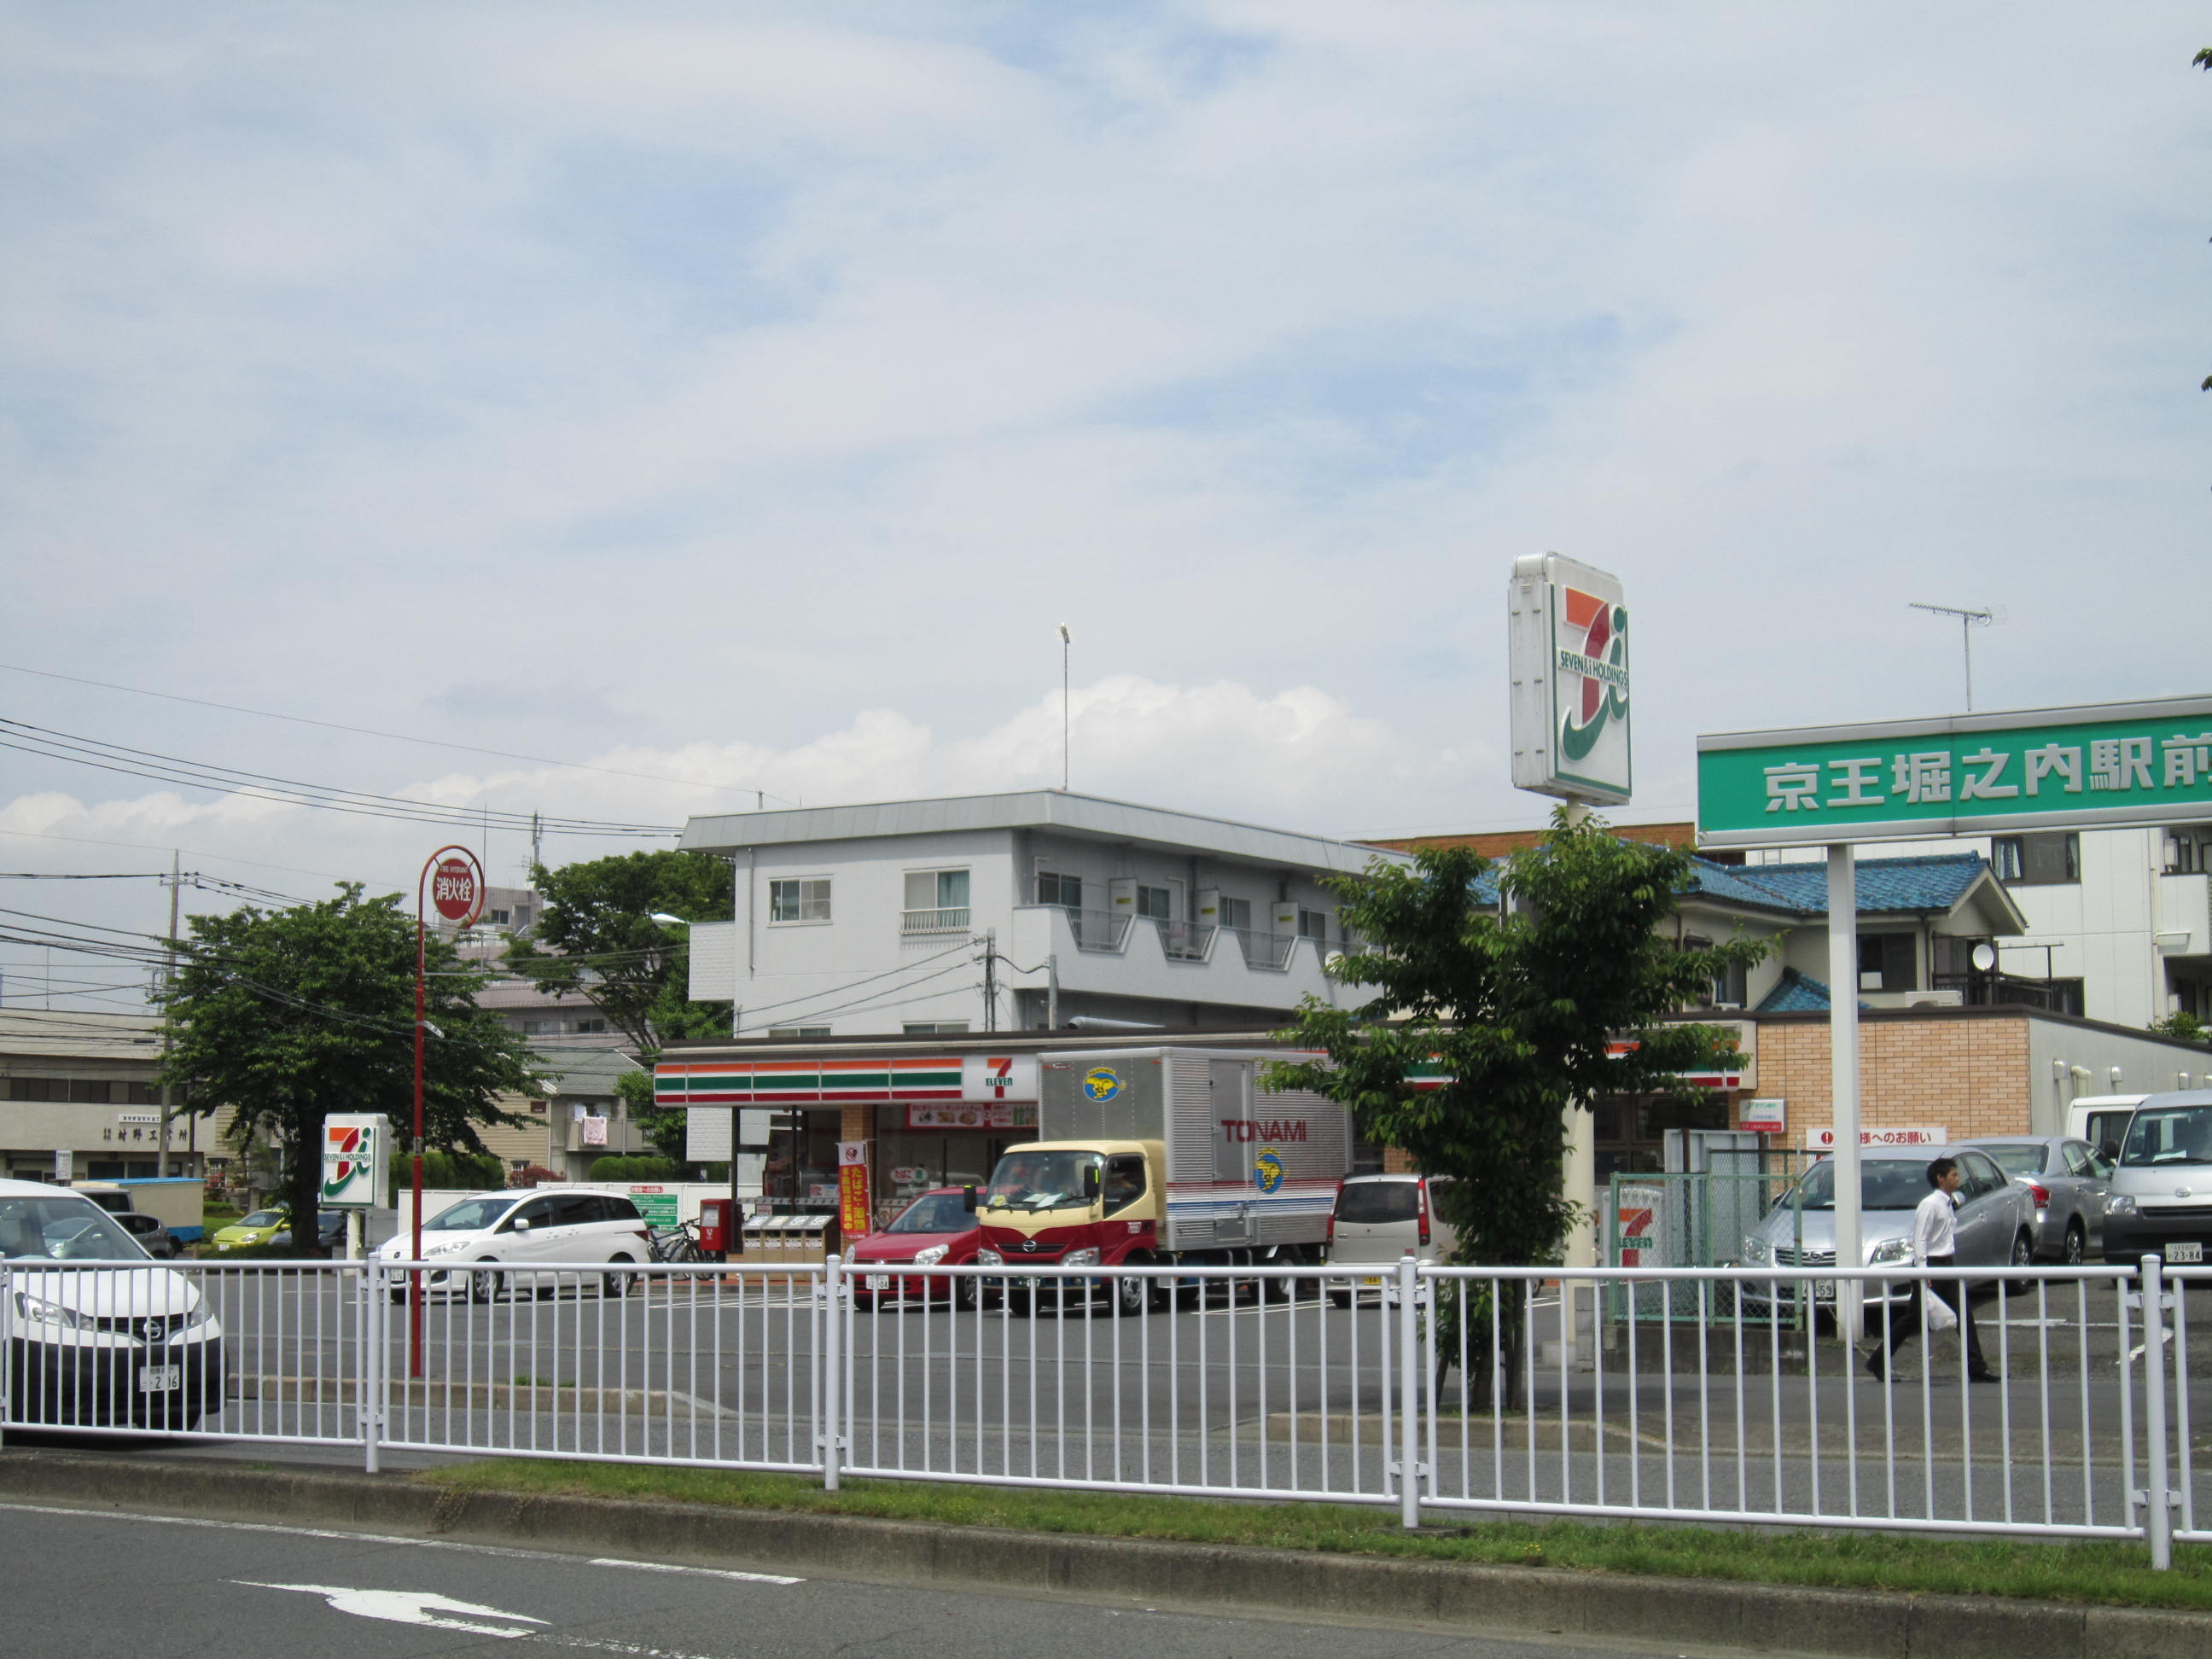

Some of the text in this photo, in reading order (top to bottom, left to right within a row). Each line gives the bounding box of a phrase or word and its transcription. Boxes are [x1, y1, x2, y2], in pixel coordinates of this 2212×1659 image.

[1592, 661, 1628, 687] HOLDINGS
[1763, 732, 2212, 812] 京王堀之内駅前
[436, 876, 472, 901] 消火栓
[1221, 1120, 1307, 1142] TONAMI
